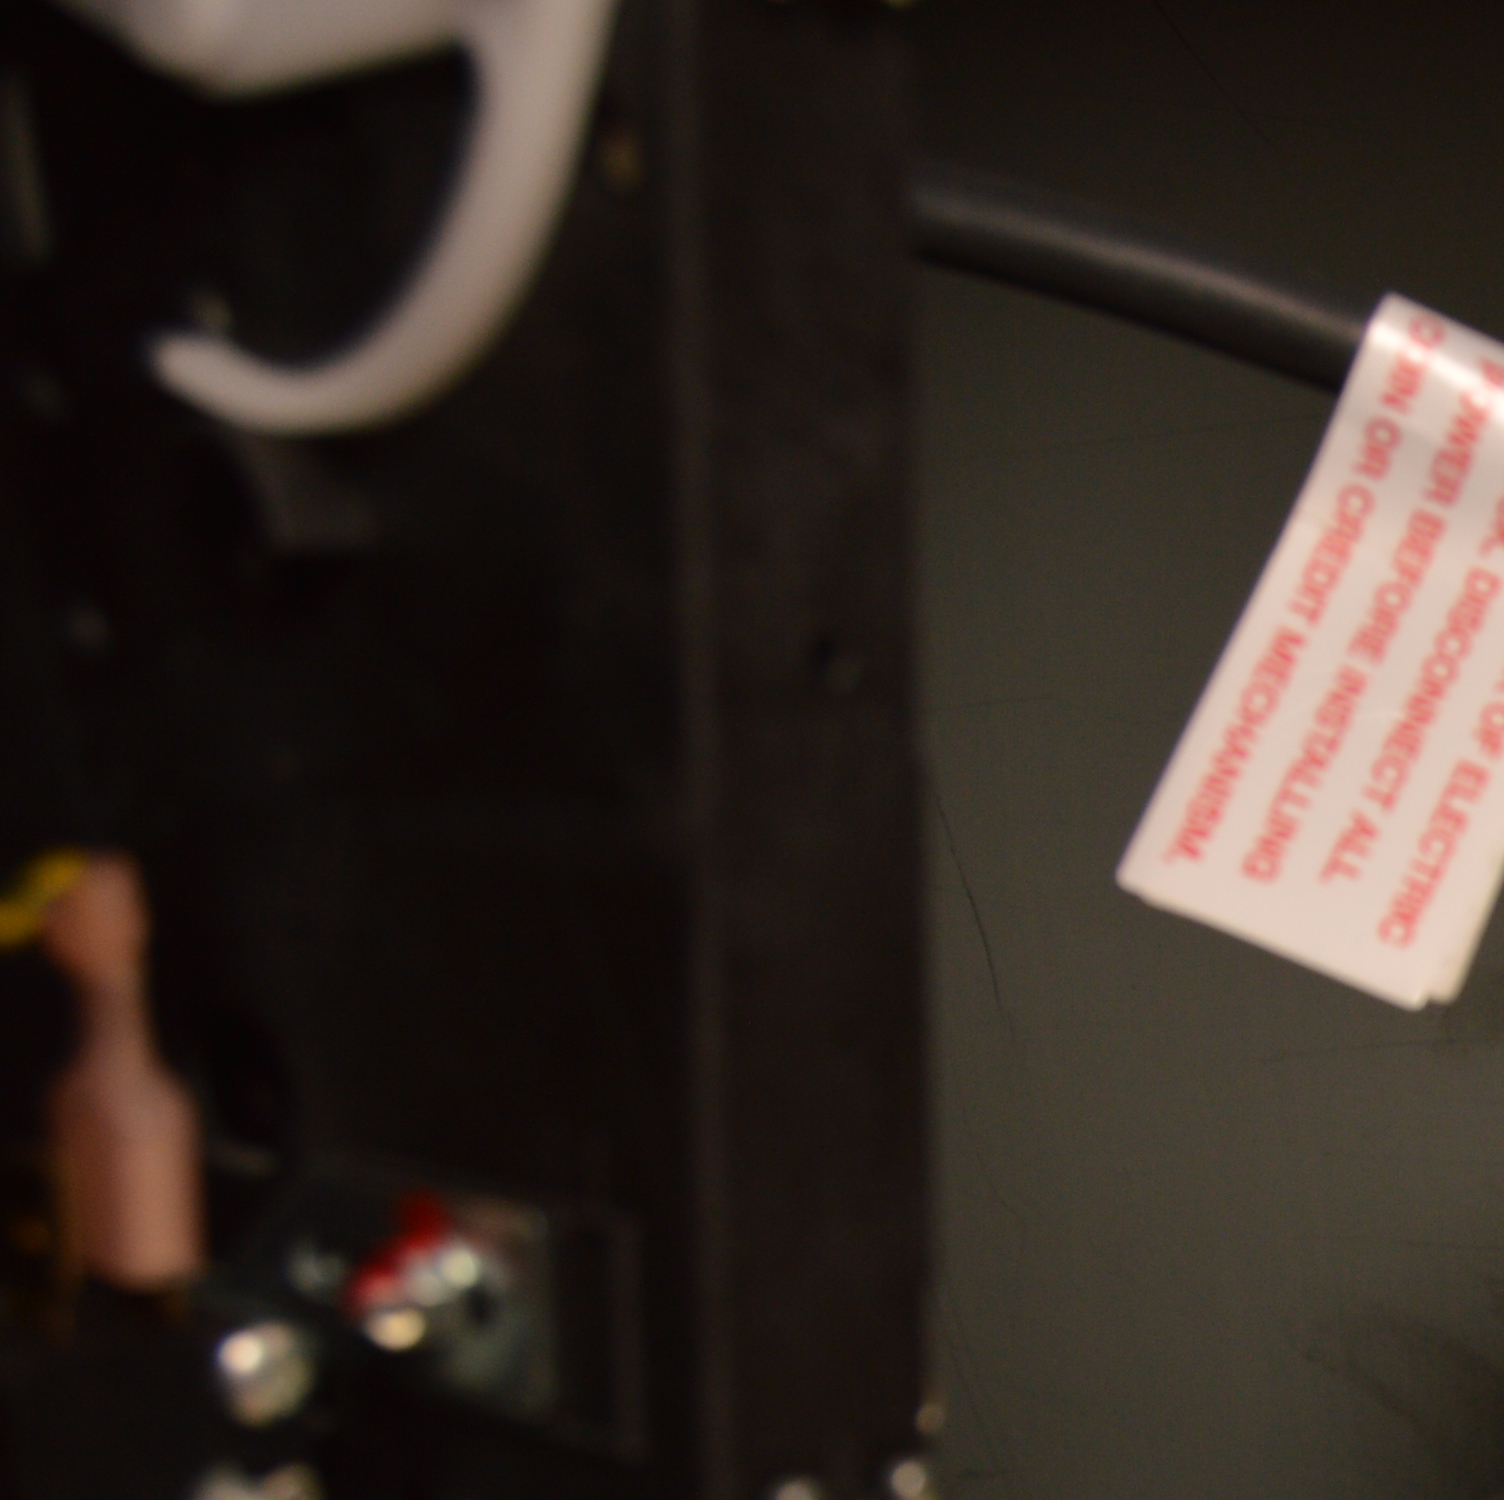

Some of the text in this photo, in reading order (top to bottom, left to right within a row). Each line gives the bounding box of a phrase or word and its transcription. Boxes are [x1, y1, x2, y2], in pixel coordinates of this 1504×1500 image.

[1355, 417, 1400, 479] OR
[1290, 484, 1374, 626] CREDIT
[1348, 510, 1445, 663] BEFORE
[1165, 626, 1307, 861] MECHANISM.
[1365, 567, 1502, 810] DISCONNECT
[1241, 666, 1367, 882] INSTALLING
[1320, 811, 1379, 881] ALL
[1377, 760, 1490, 946] ELECTRIC
